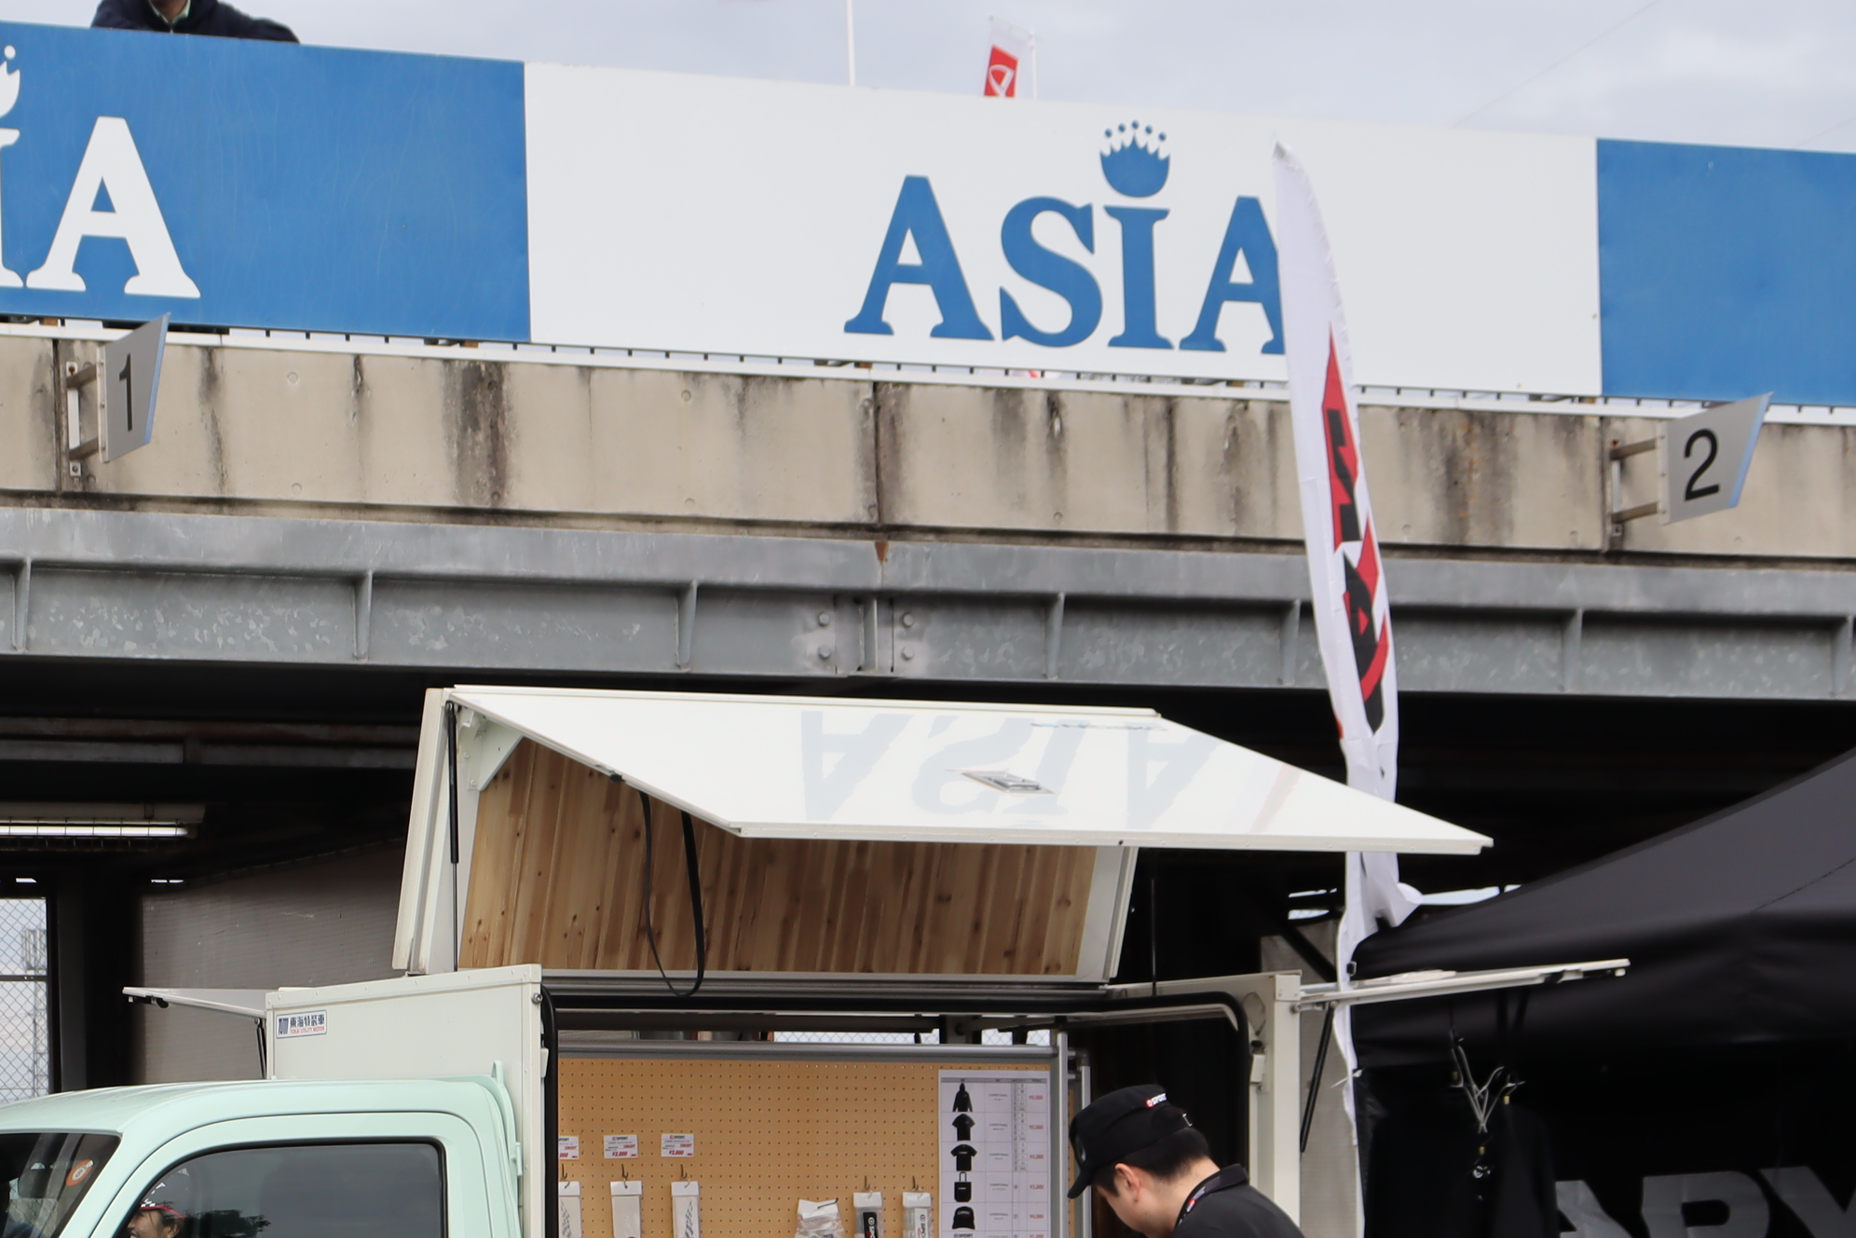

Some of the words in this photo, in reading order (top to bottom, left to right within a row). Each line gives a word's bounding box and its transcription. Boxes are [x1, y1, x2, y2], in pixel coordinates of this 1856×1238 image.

[843, 174, 1286, 356] ASIA
[118, 352, 134, 432] 1
[1684, 427, 1720, 502] 2
